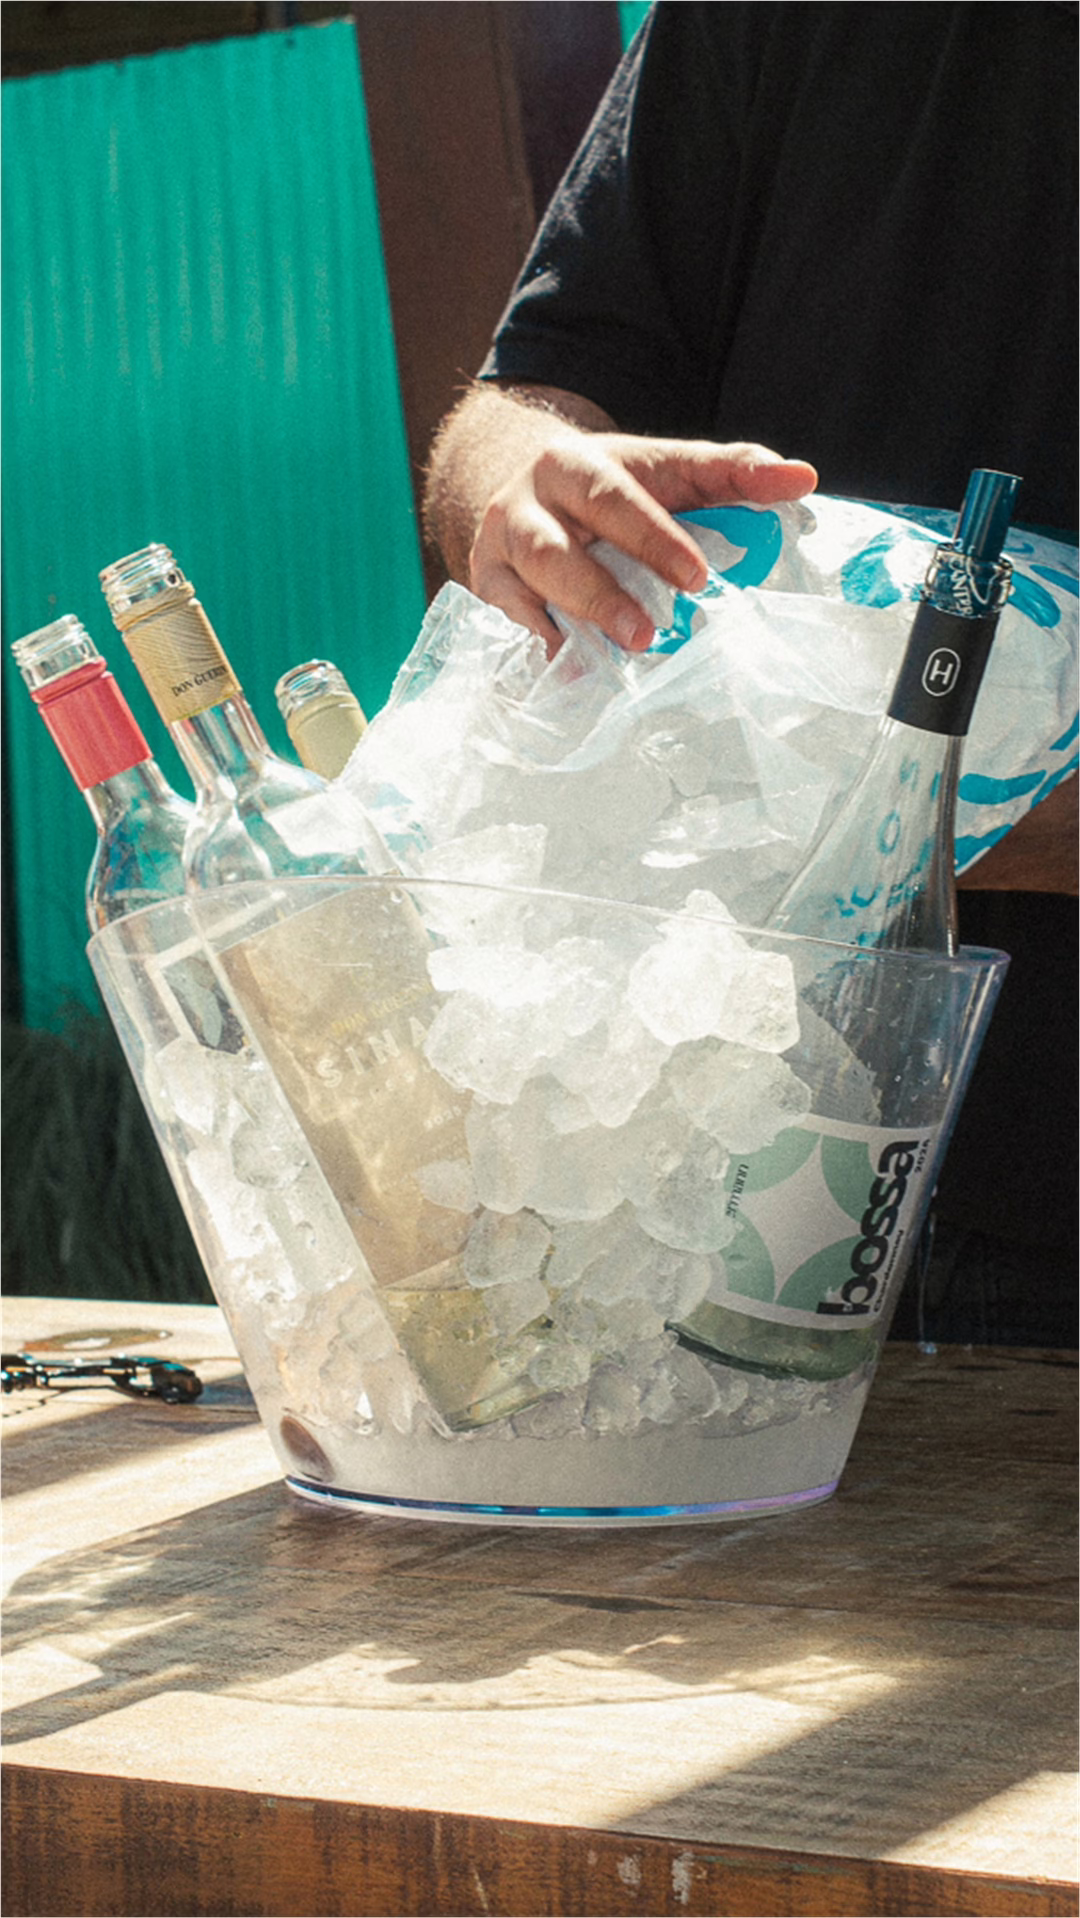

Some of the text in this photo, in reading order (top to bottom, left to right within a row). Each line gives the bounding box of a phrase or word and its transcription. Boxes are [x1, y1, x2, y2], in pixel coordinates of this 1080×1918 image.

[171, 681, 194, 697] DON
[928, 658, 952, 686] H
[315, 1004, 441, 1089] SINA
[815, 1140, 921, 1316] bossa
